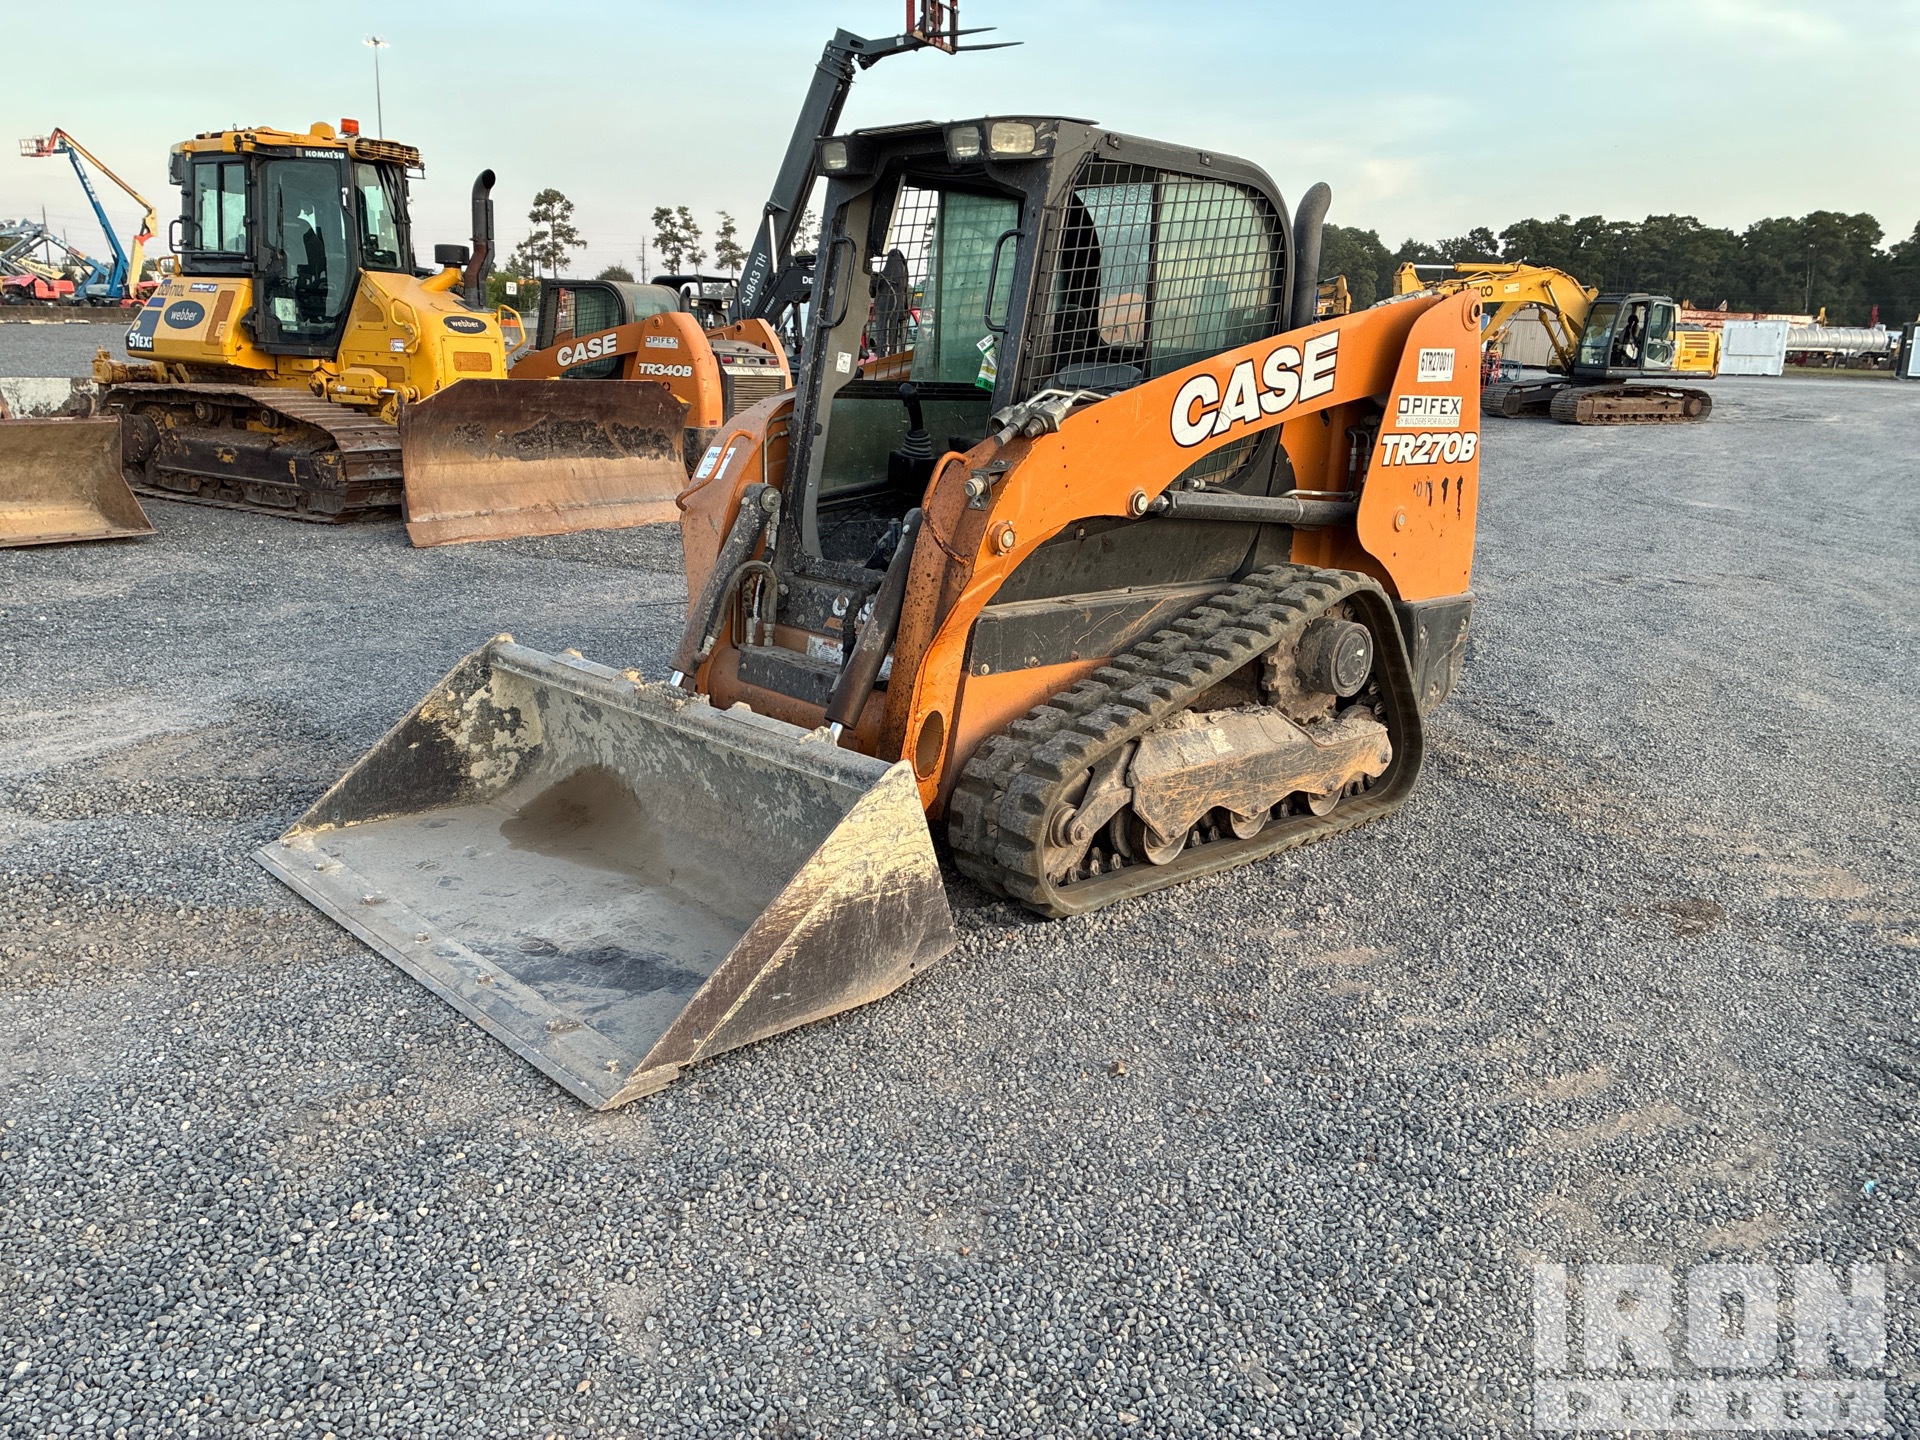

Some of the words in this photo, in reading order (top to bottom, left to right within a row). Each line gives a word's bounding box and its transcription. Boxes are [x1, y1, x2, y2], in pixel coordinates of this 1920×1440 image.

[305, 150, 345, 159] KOMATSU
[742, 270, 761, 306] SJ843
[755, 252, 767, 267] TH
[802, 276, 814, 284] DE
[171, 308, 198, 321] webber
[451, 319, 479, 328] webber
[645, 336, 677, 345] OPIFEX
[556, 332, 618, 367] CASE
[638, 362, 693, 377] TR340B
[1170, 328, 1340, 448] CASE
[1397, 397, 1460, 415] OPIFEX
[1405, 417, 1427, 425] BUILDERS
[1428, 417, 1437, 425] FOR
[1438, 417, 1459, 425] BUILDERS
[1381, 431, 1478, 467] TR270B
